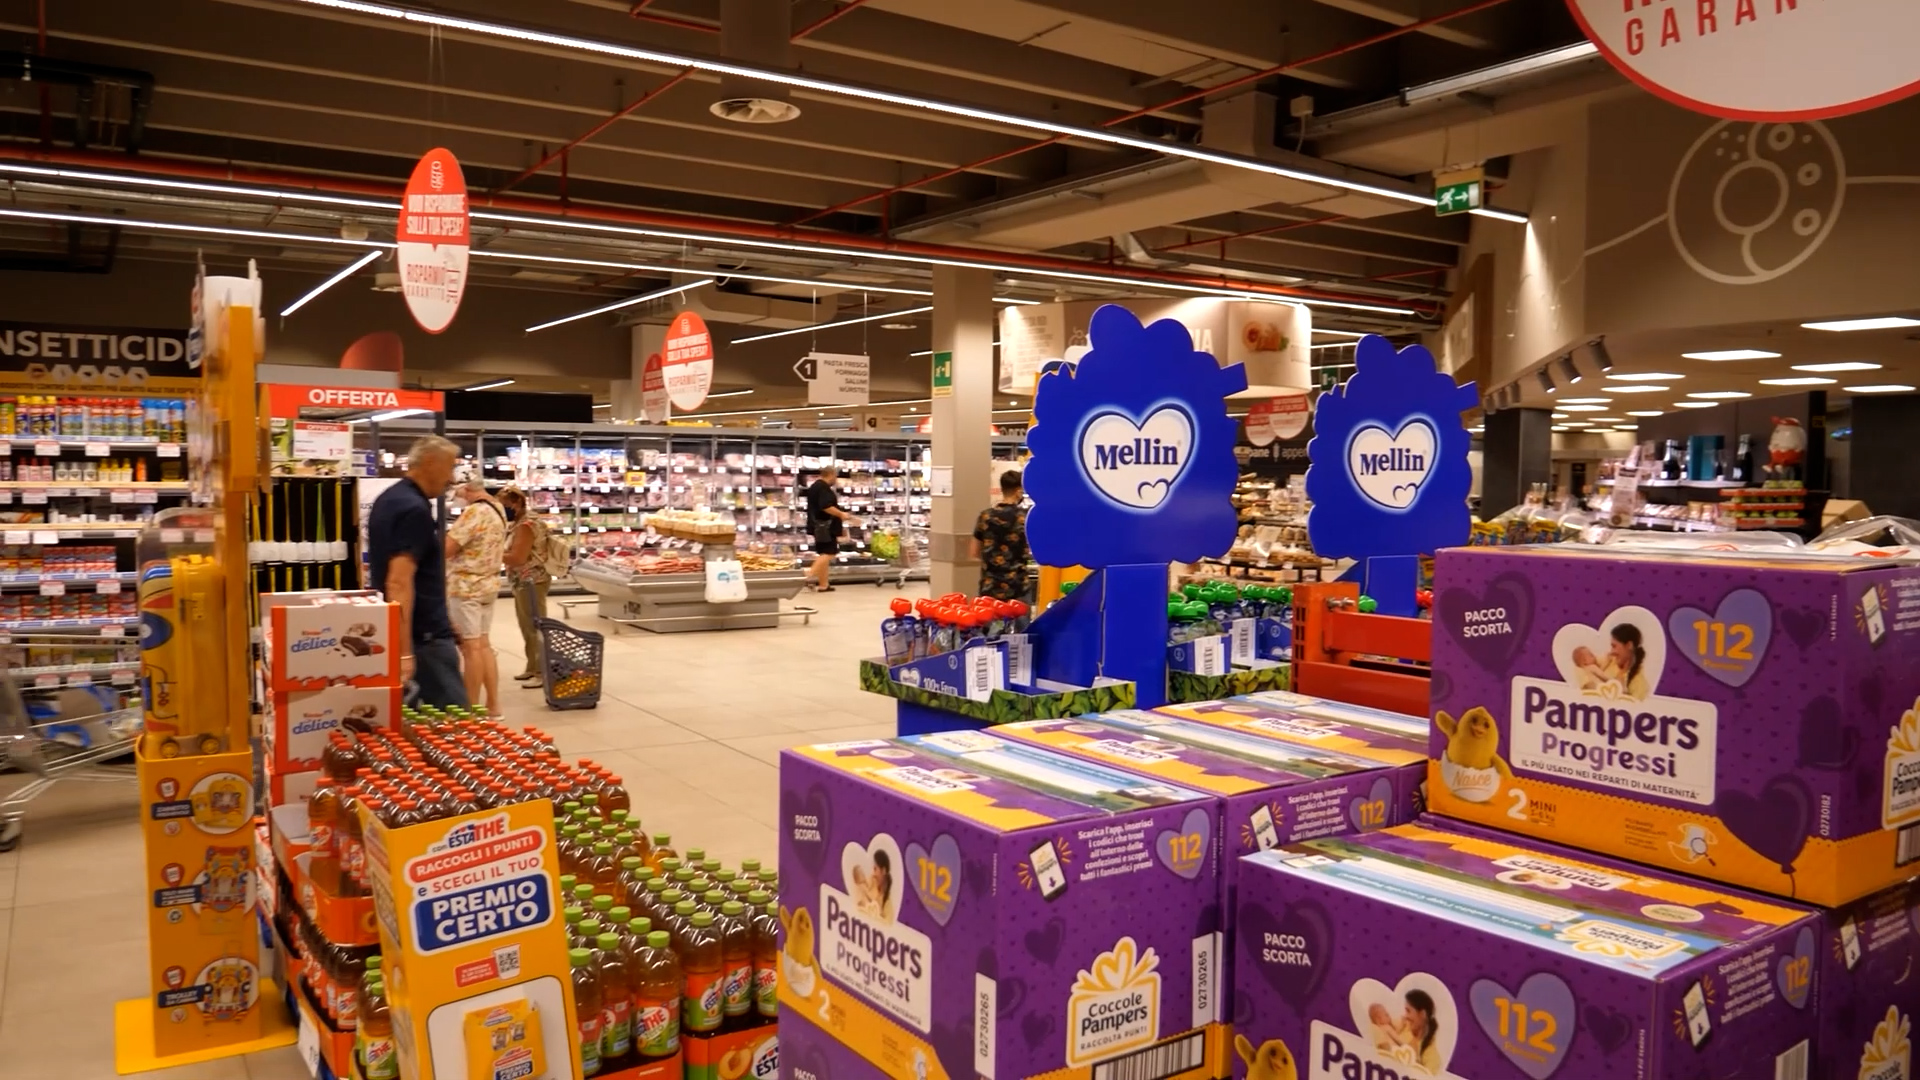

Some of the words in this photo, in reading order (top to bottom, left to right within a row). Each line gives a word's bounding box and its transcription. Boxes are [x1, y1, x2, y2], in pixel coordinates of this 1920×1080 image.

[804, 363, 812, 375] 1
[308, 388, 399, 406] OFFERTA
[1094, 438, 1179, 470] Mellin
[1360, 448, 1424, 476] Mellin
[1464, 608, 1506, 622] PACCO
[1464, 622, 1512, 638] SCORTA
[1694, 620, 1754, 661] 112
[1524, 686, 1700, 750] Pampers
[1542, 732, 1677, 778] Progressi
[1453, 771, 1492, 786] Nasce
[1530, 760, 1544, 770] PIÙ
[1547, 764, 1573, 776] USATO
[1576, 769, 1590, 778] NEI
[1592, 773, 1629, 786] REPARTI
[1631, 780, 1641, 788] DI
[1359, 800, 1384, 826] 112
[1506, 788, 1527, 820] 2
[1530, 800, 1556, 813] MINI
[1820, 795, 1831, 835] 02730182
[794, 814, 818, 827] PACCO
[794, 828, 821, 842] SCORTA
[1078, 828, 1104, 840] Scarica
[1124, 818, 1154, 831] inserisci
[416, 849, 483, 876] RACCOGLI
[494, 835, 533, 855] PUNTI
[432, 844, 448, 853] con
[1092, 836, 1113, 847] codici
[1115, 834, 1127, 843] che
[1169, 833, 1202, 863] 112
[1085, 855, 1122, 870] confezioni
[1127, 850, 1148, 861] scopri
[1100, 865, 1132, 877] fantastici
[418, 887, 427, 896] e
[433, 870, 485, 893] SCEGLI
[490, 867, 504, 878] IL
[508, 857, 540, 873] TUO
[917, 857, 952, 902] 112
[432, 880, 537, 920] PREMIO
[436, 900, 538, 941] CERTO
[827, 894, 922, 979] Pampers
[1264, 932, 1306, 949] PACCO
[837, 942, 911, 1002] Progressi
[1263, 949, 1312, 967] SCORTA
[1198, 951, 1207, 1009] 02730265
[1785, 955, 1809, 992] 112
[818, 989, 830, 1022] 2
[1088, 992, 1142, 1017] Coccole
[979, 992, 989, 1057] 02730265
[1081, 1005, 1148, 1037] Pampers
[1495, 998, 1557, 1052] 112
[1080, 1034, 1122, 1050] RACCOLTA
[1123, 1026, 1147, 1039] PUNTI
